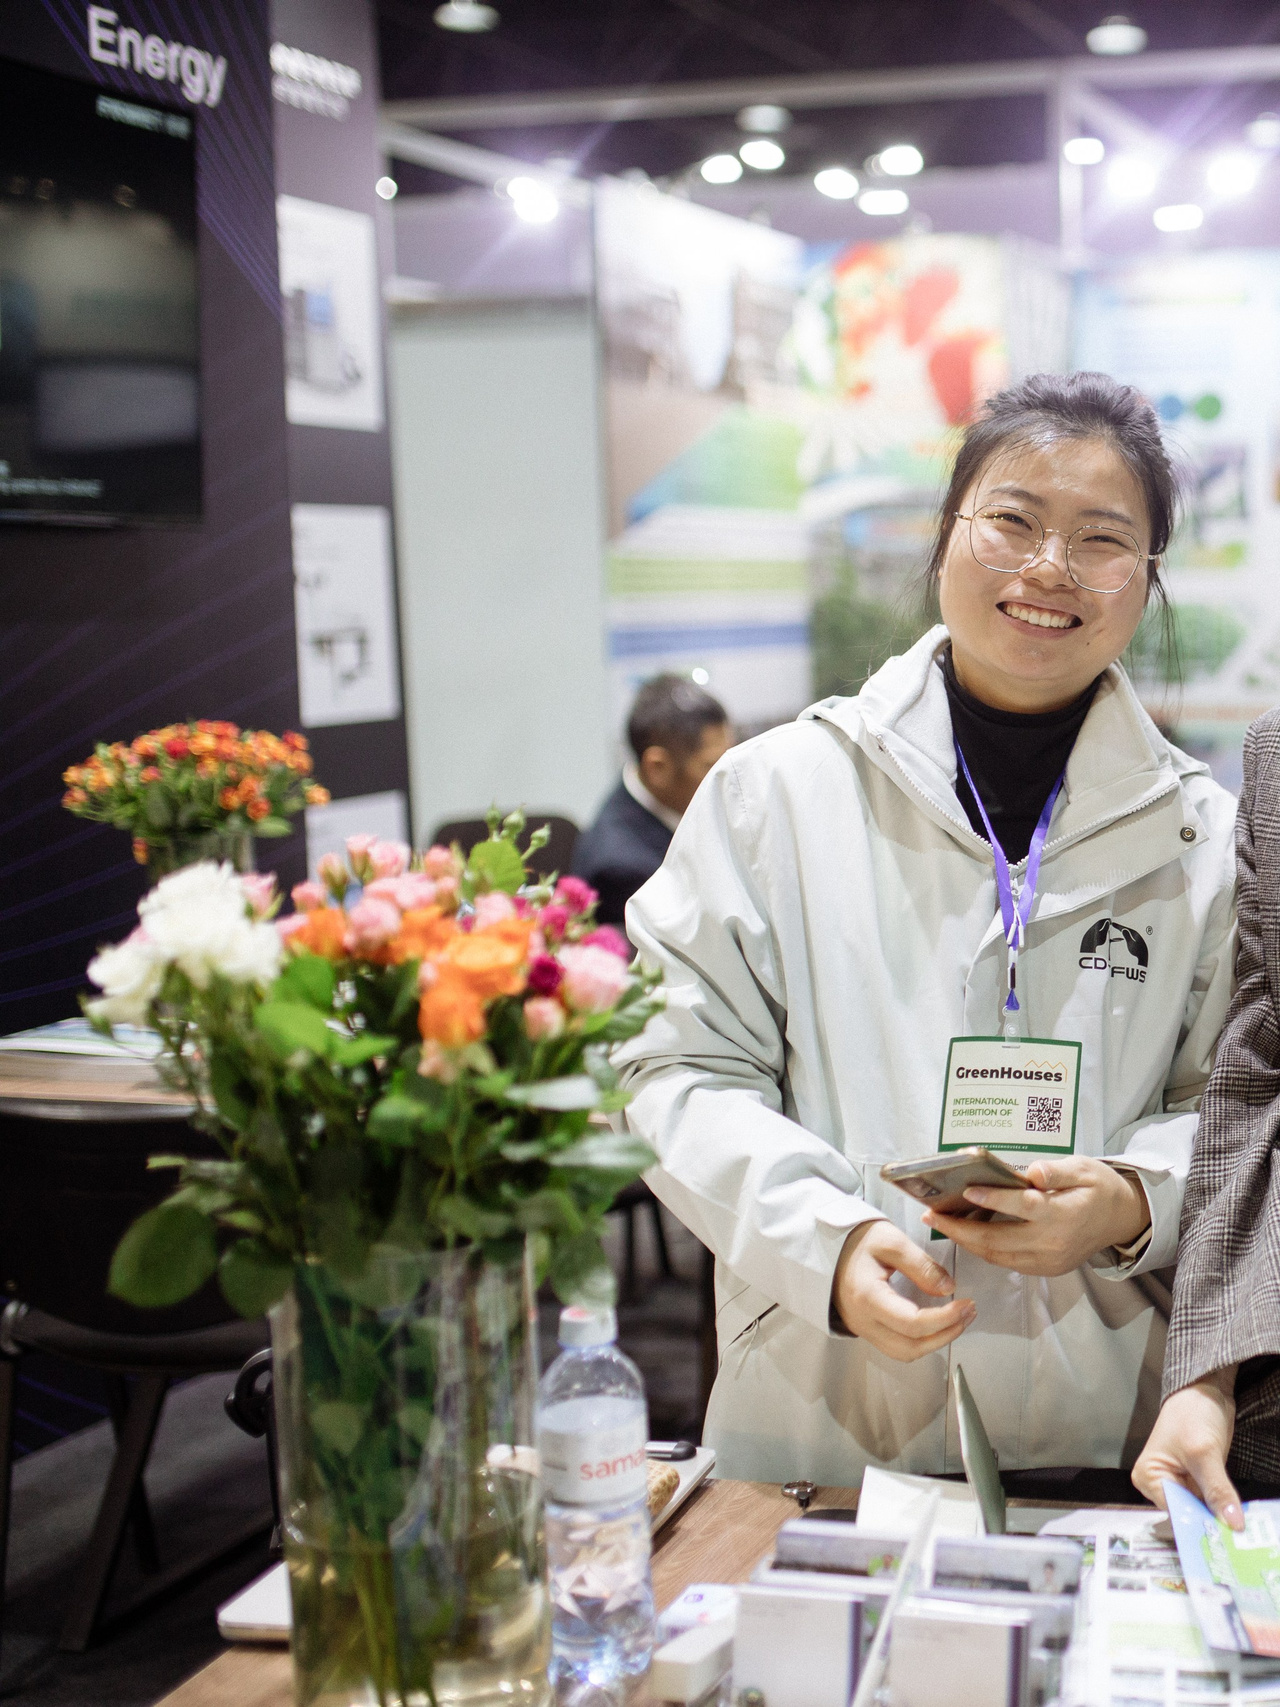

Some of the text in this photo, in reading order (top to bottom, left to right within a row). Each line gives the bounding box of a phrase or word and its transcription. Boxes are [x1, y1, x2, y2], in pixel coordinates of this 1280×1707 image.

[87, 4, 228, 108] Energy
[956, 1066, 1063, 1082] GreenHouses
[953, 1097, 1020, 1106] INTERNATIONAL
[952, 1108, 1013, 1117] EXHIBITION OF
[951, 1119, 1013, 1128] GREENHOUSES
